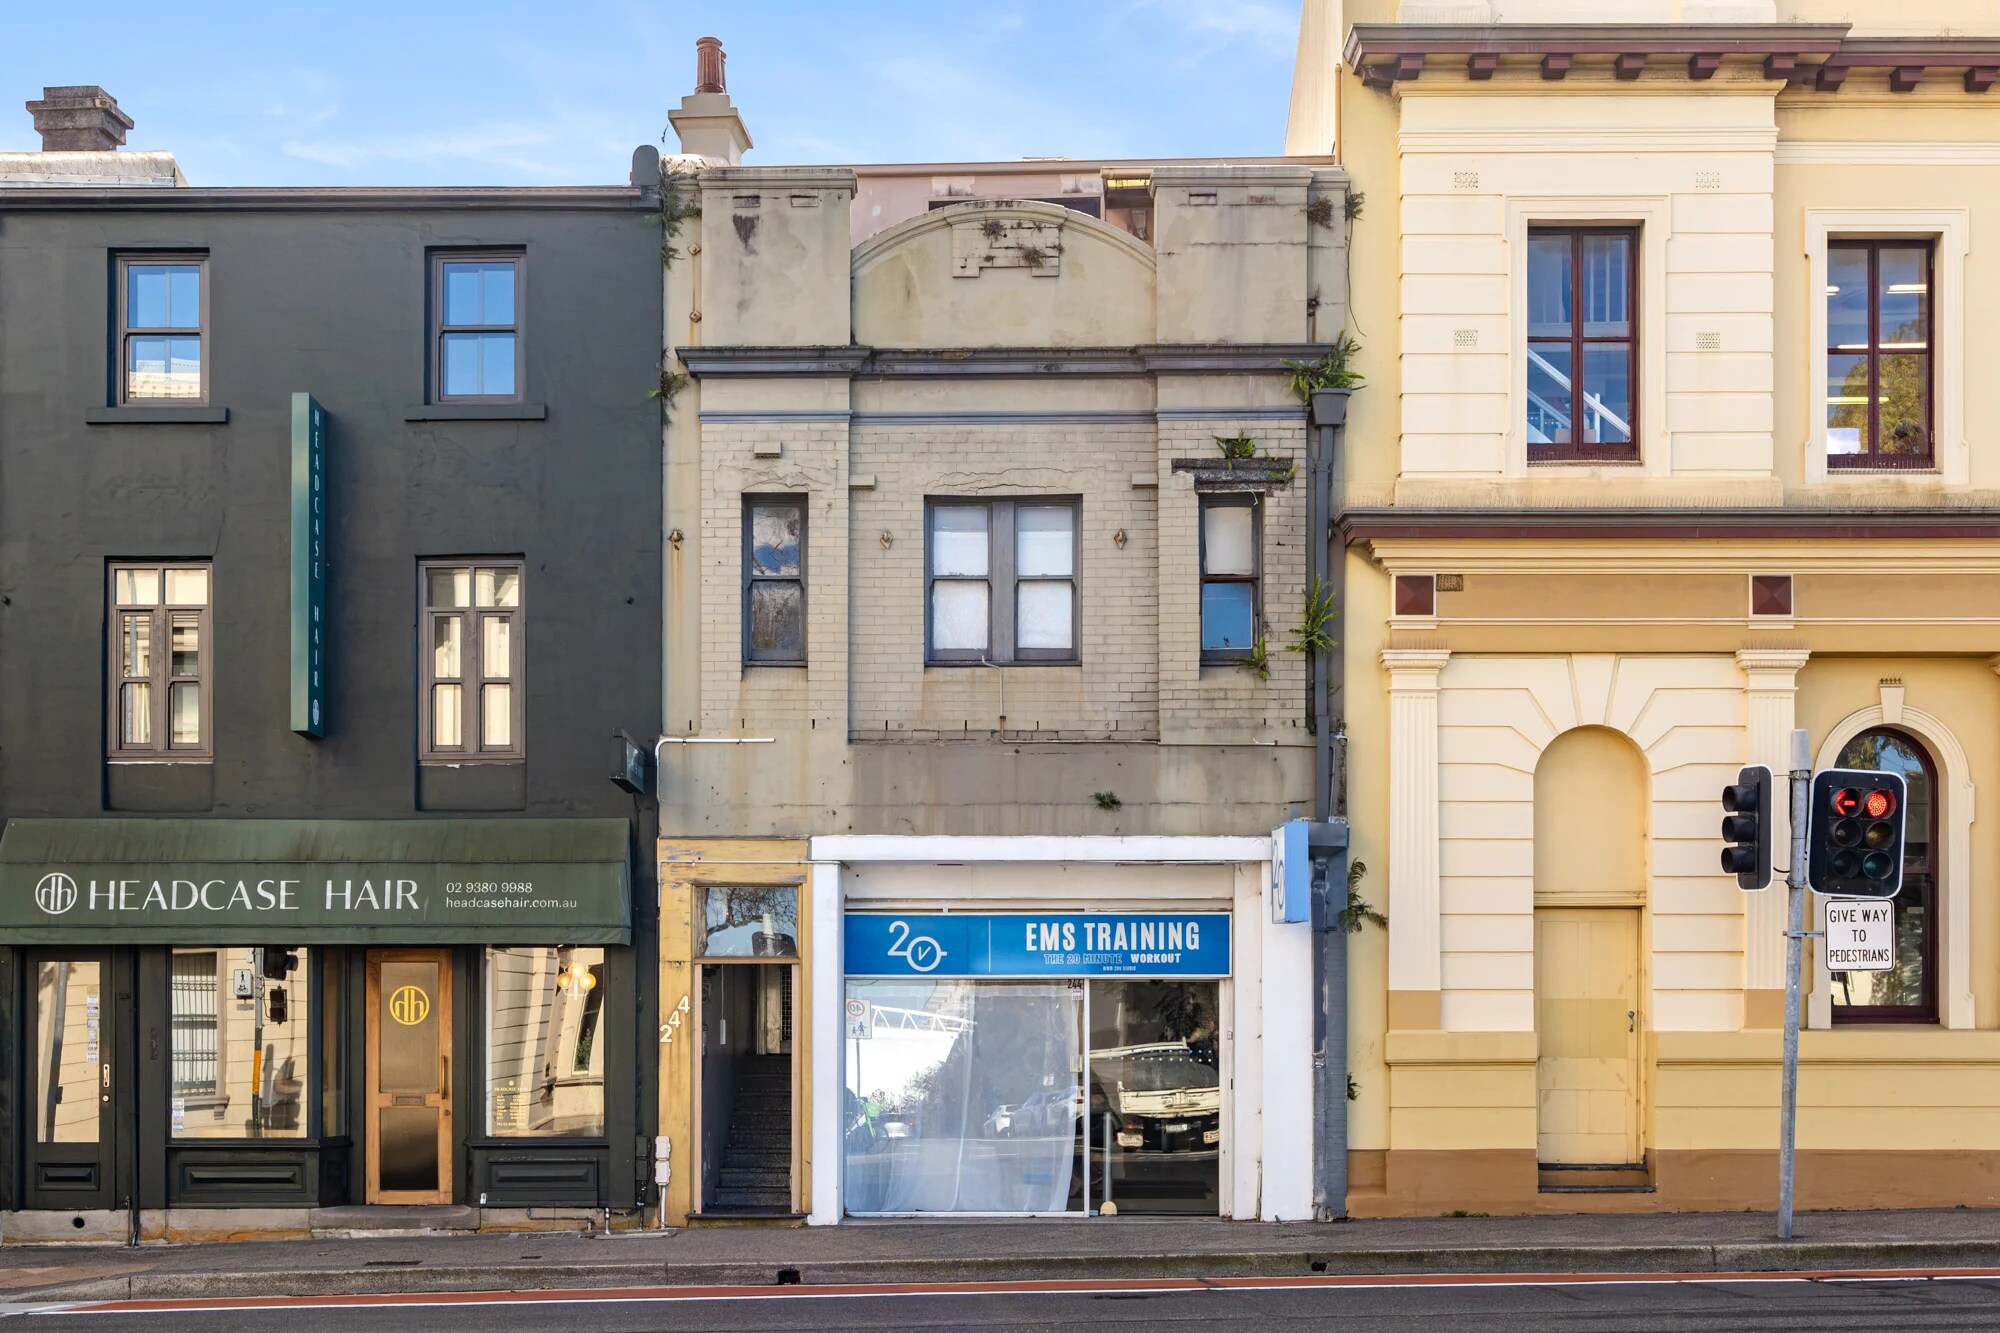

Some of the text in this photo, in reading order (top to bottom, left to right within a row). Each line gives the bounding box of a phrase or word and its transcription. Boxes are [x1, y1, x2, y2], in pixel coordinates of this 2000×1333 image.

[446, 882, 533, 893] 02 9380 9988
[89, 879, 420, 910] HEADCASE HAIR
[446, 897, 577, 908] headcasehair.com.au
[1829, 909, 1888, 922] GIVE WAY
[1026, 922, 1200, 951] EMS TRAINING
[1852, 929, 1867, 942] TO
[1043, 953, 1182, 965] THE 20 MINUTE WORKOUT
[1829, 949, 1890, 962] PEDESTRIANS
[1067, 979, 1082, 989] 244
